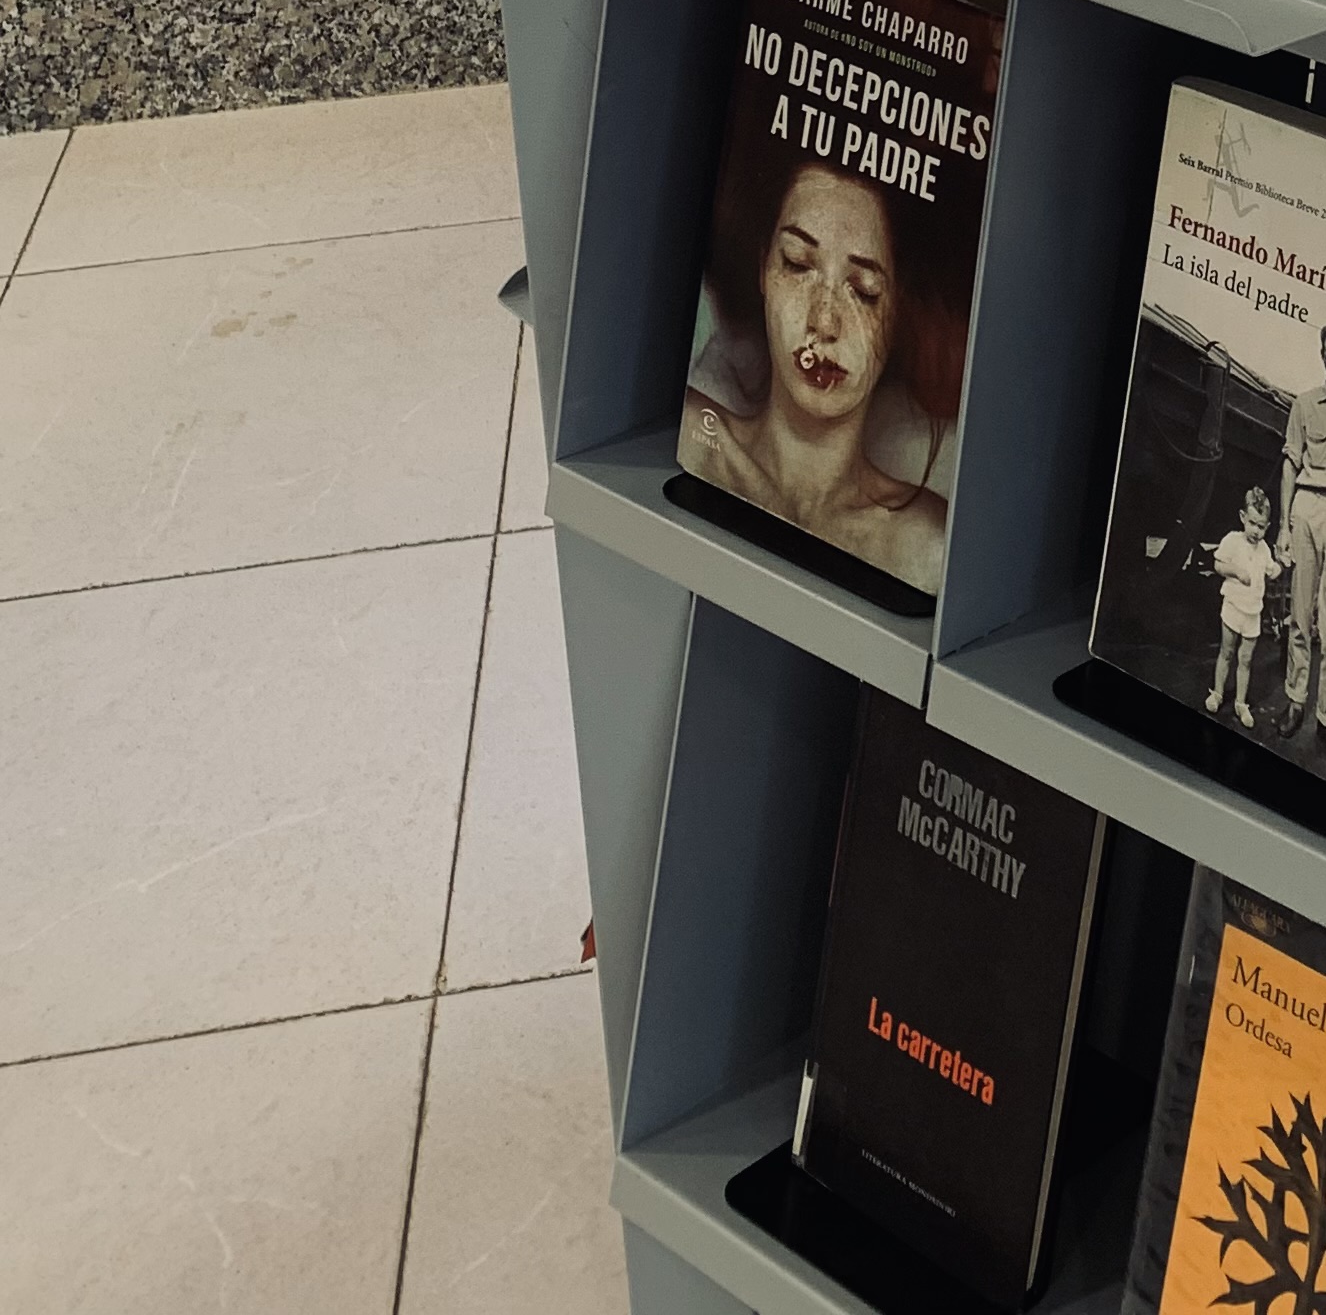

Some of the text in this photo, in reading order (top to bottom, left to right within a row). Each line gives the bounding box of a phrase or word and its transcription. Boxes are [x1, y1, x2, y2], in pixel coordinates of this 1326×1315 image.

[862, 1, 969, 65] CHAPARRO
[745, 23, 991, 160] NO DECEPCIONES
[770, 94, 941, 202] A TU PADRE
[1168, 204, 1268, 265] Fernando
[1162, 244, 1309, 323] La isla del padre
[917, 759, 1016, 845] CORMAC
[897, 795, 1026, 899] McCARTHY
[868, 996, 995, 1107] La carretera
[1225, 1002, 1293, 1059] Ordesa
